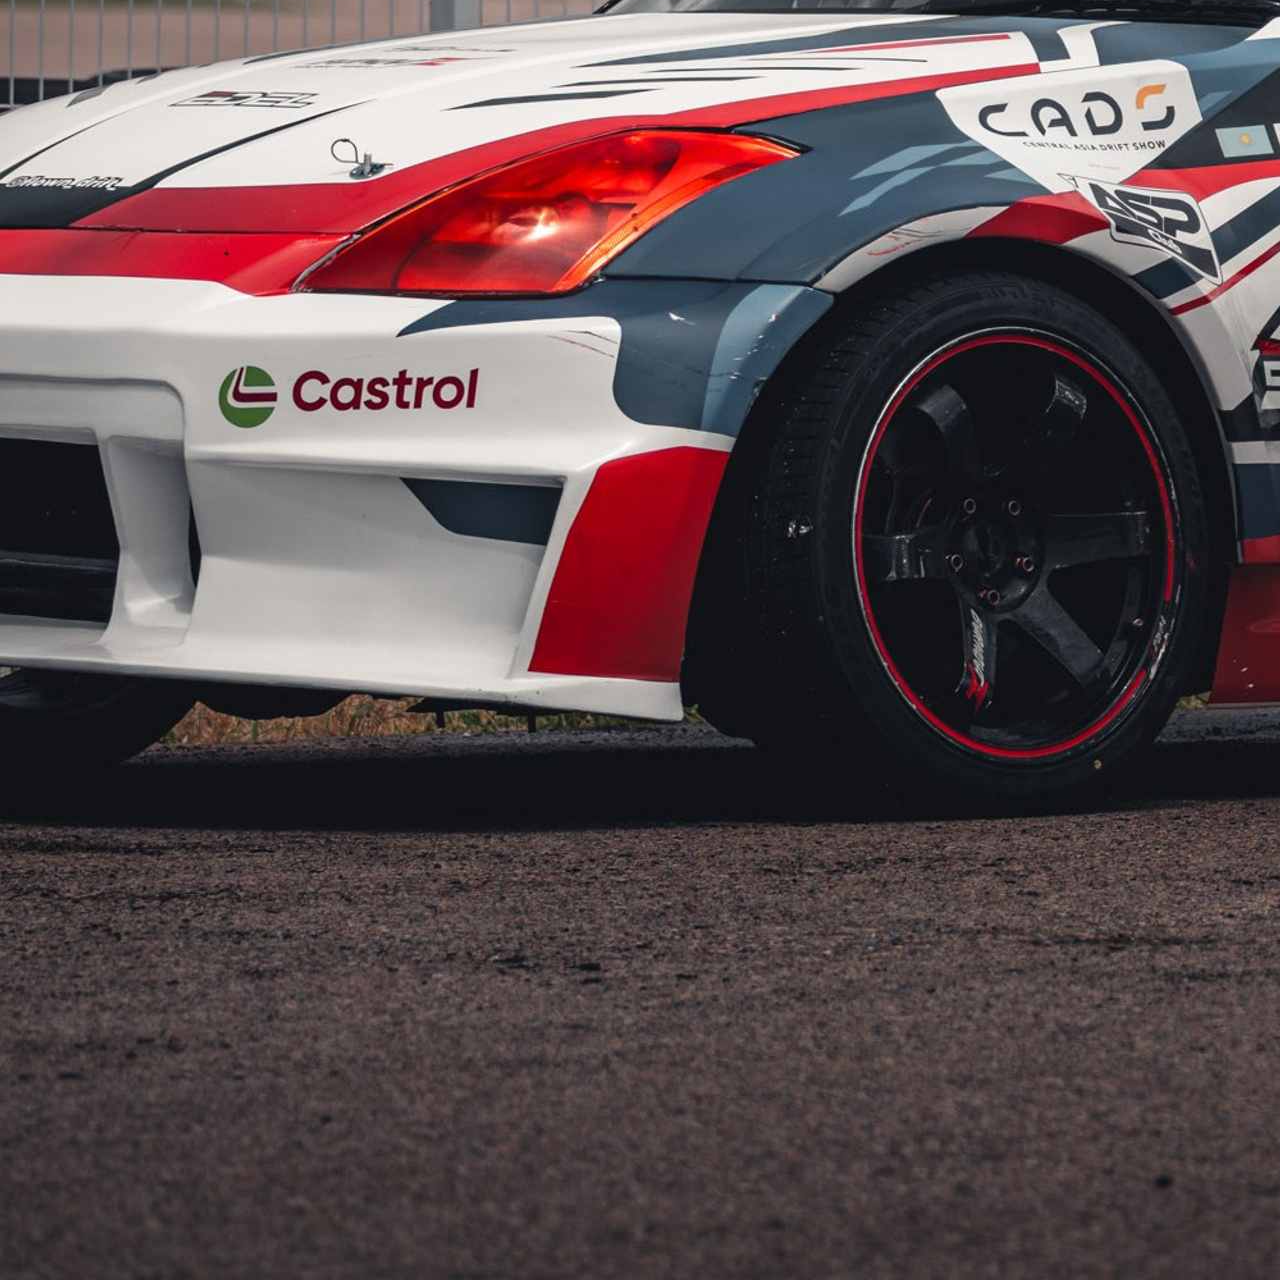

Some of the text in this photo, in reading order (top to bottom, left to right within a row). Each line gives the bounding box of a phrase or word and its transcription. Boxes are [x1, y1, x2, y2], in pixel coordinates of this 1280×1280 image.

[978, 83, 1176, 137] CADS
[1022, 139, 1167, 152] CENTRAL ASIA DRIFT SHOW
[292, 368, 480, 412] Castrol
